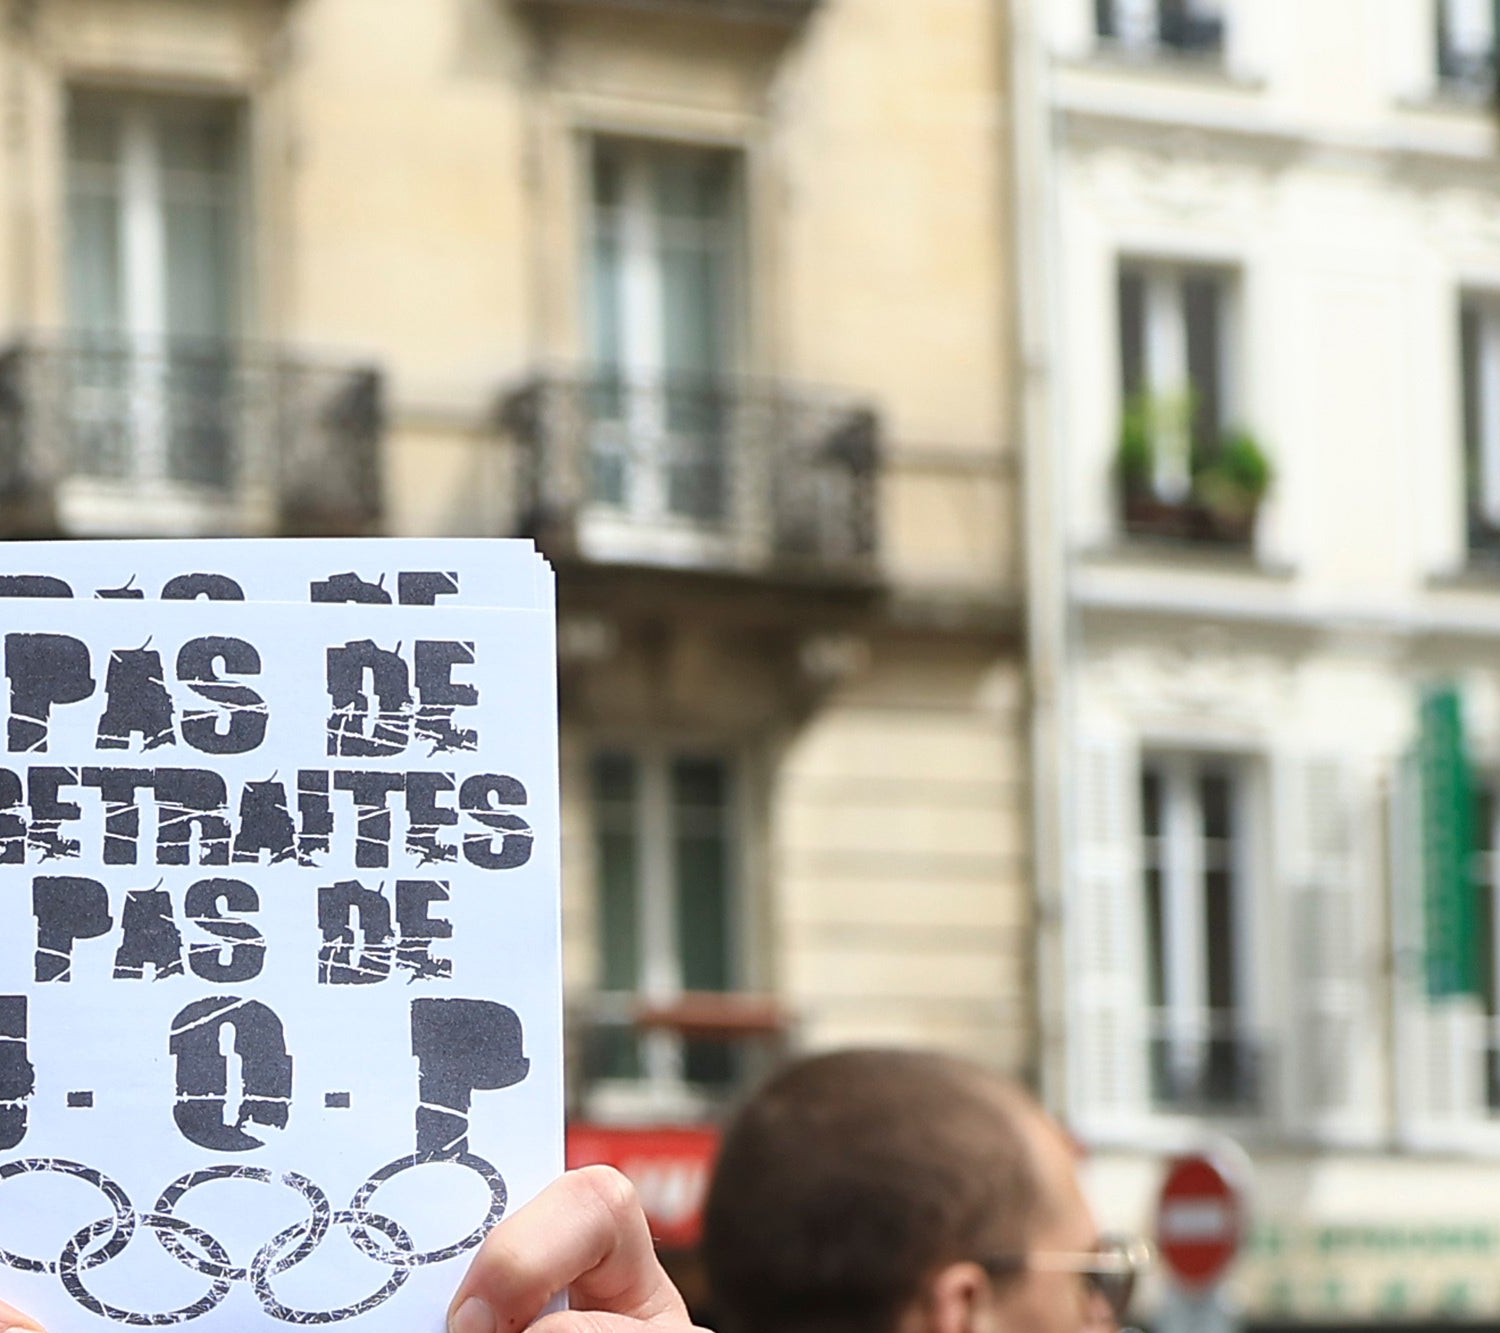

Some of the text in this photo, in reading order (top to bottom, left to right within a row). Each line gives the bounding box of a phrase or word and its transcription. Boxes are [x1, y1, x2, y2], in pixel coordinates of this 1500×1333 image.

[4, 632, 480, 758] PAS DE
[32, 876, 455, 985] PAS DE
